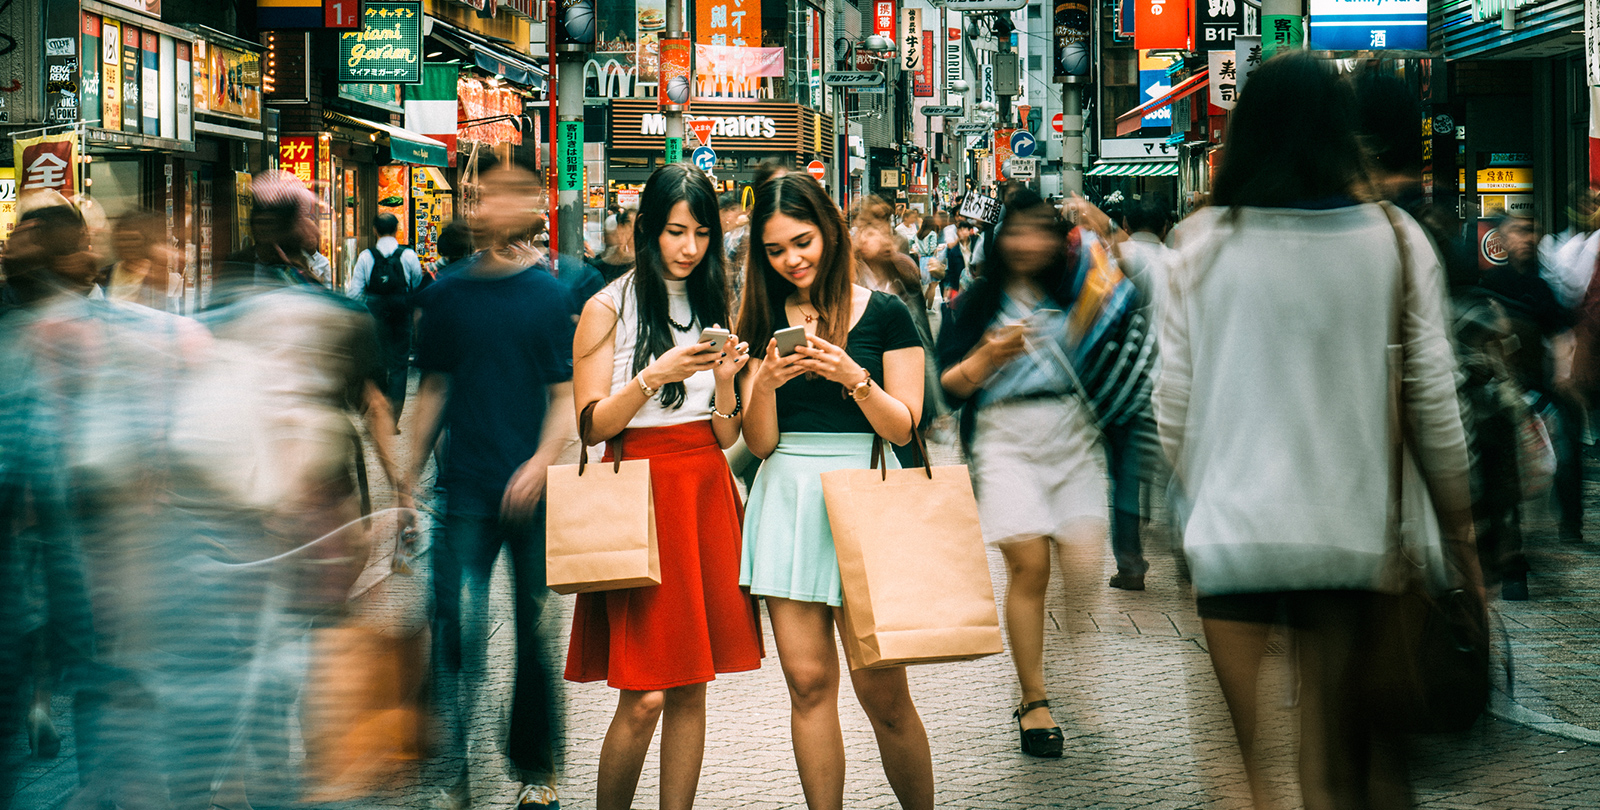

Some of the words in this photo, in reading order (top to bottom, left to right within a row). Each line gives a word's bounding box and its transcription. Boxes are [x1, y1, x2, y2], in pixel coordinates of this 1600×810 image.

[333, 3, 342, 25] 1
[348, 16, 355, 25] F
[1206, 28, 1238, 41] B1F
[1370, 30, 1386, 47] 酒
[350, 68, 408, 76] マイアミガーデン
[1219, 60, 1238, 102] 寿司
[58, 109, 76, 118] POKE
[641, 114, 776, 137] Mnald's
[566, 124, 577, 188] 客引きは犯罪です
[1143, 142, 1178, 155] マモ
[26, 152, 68, 189] 全
